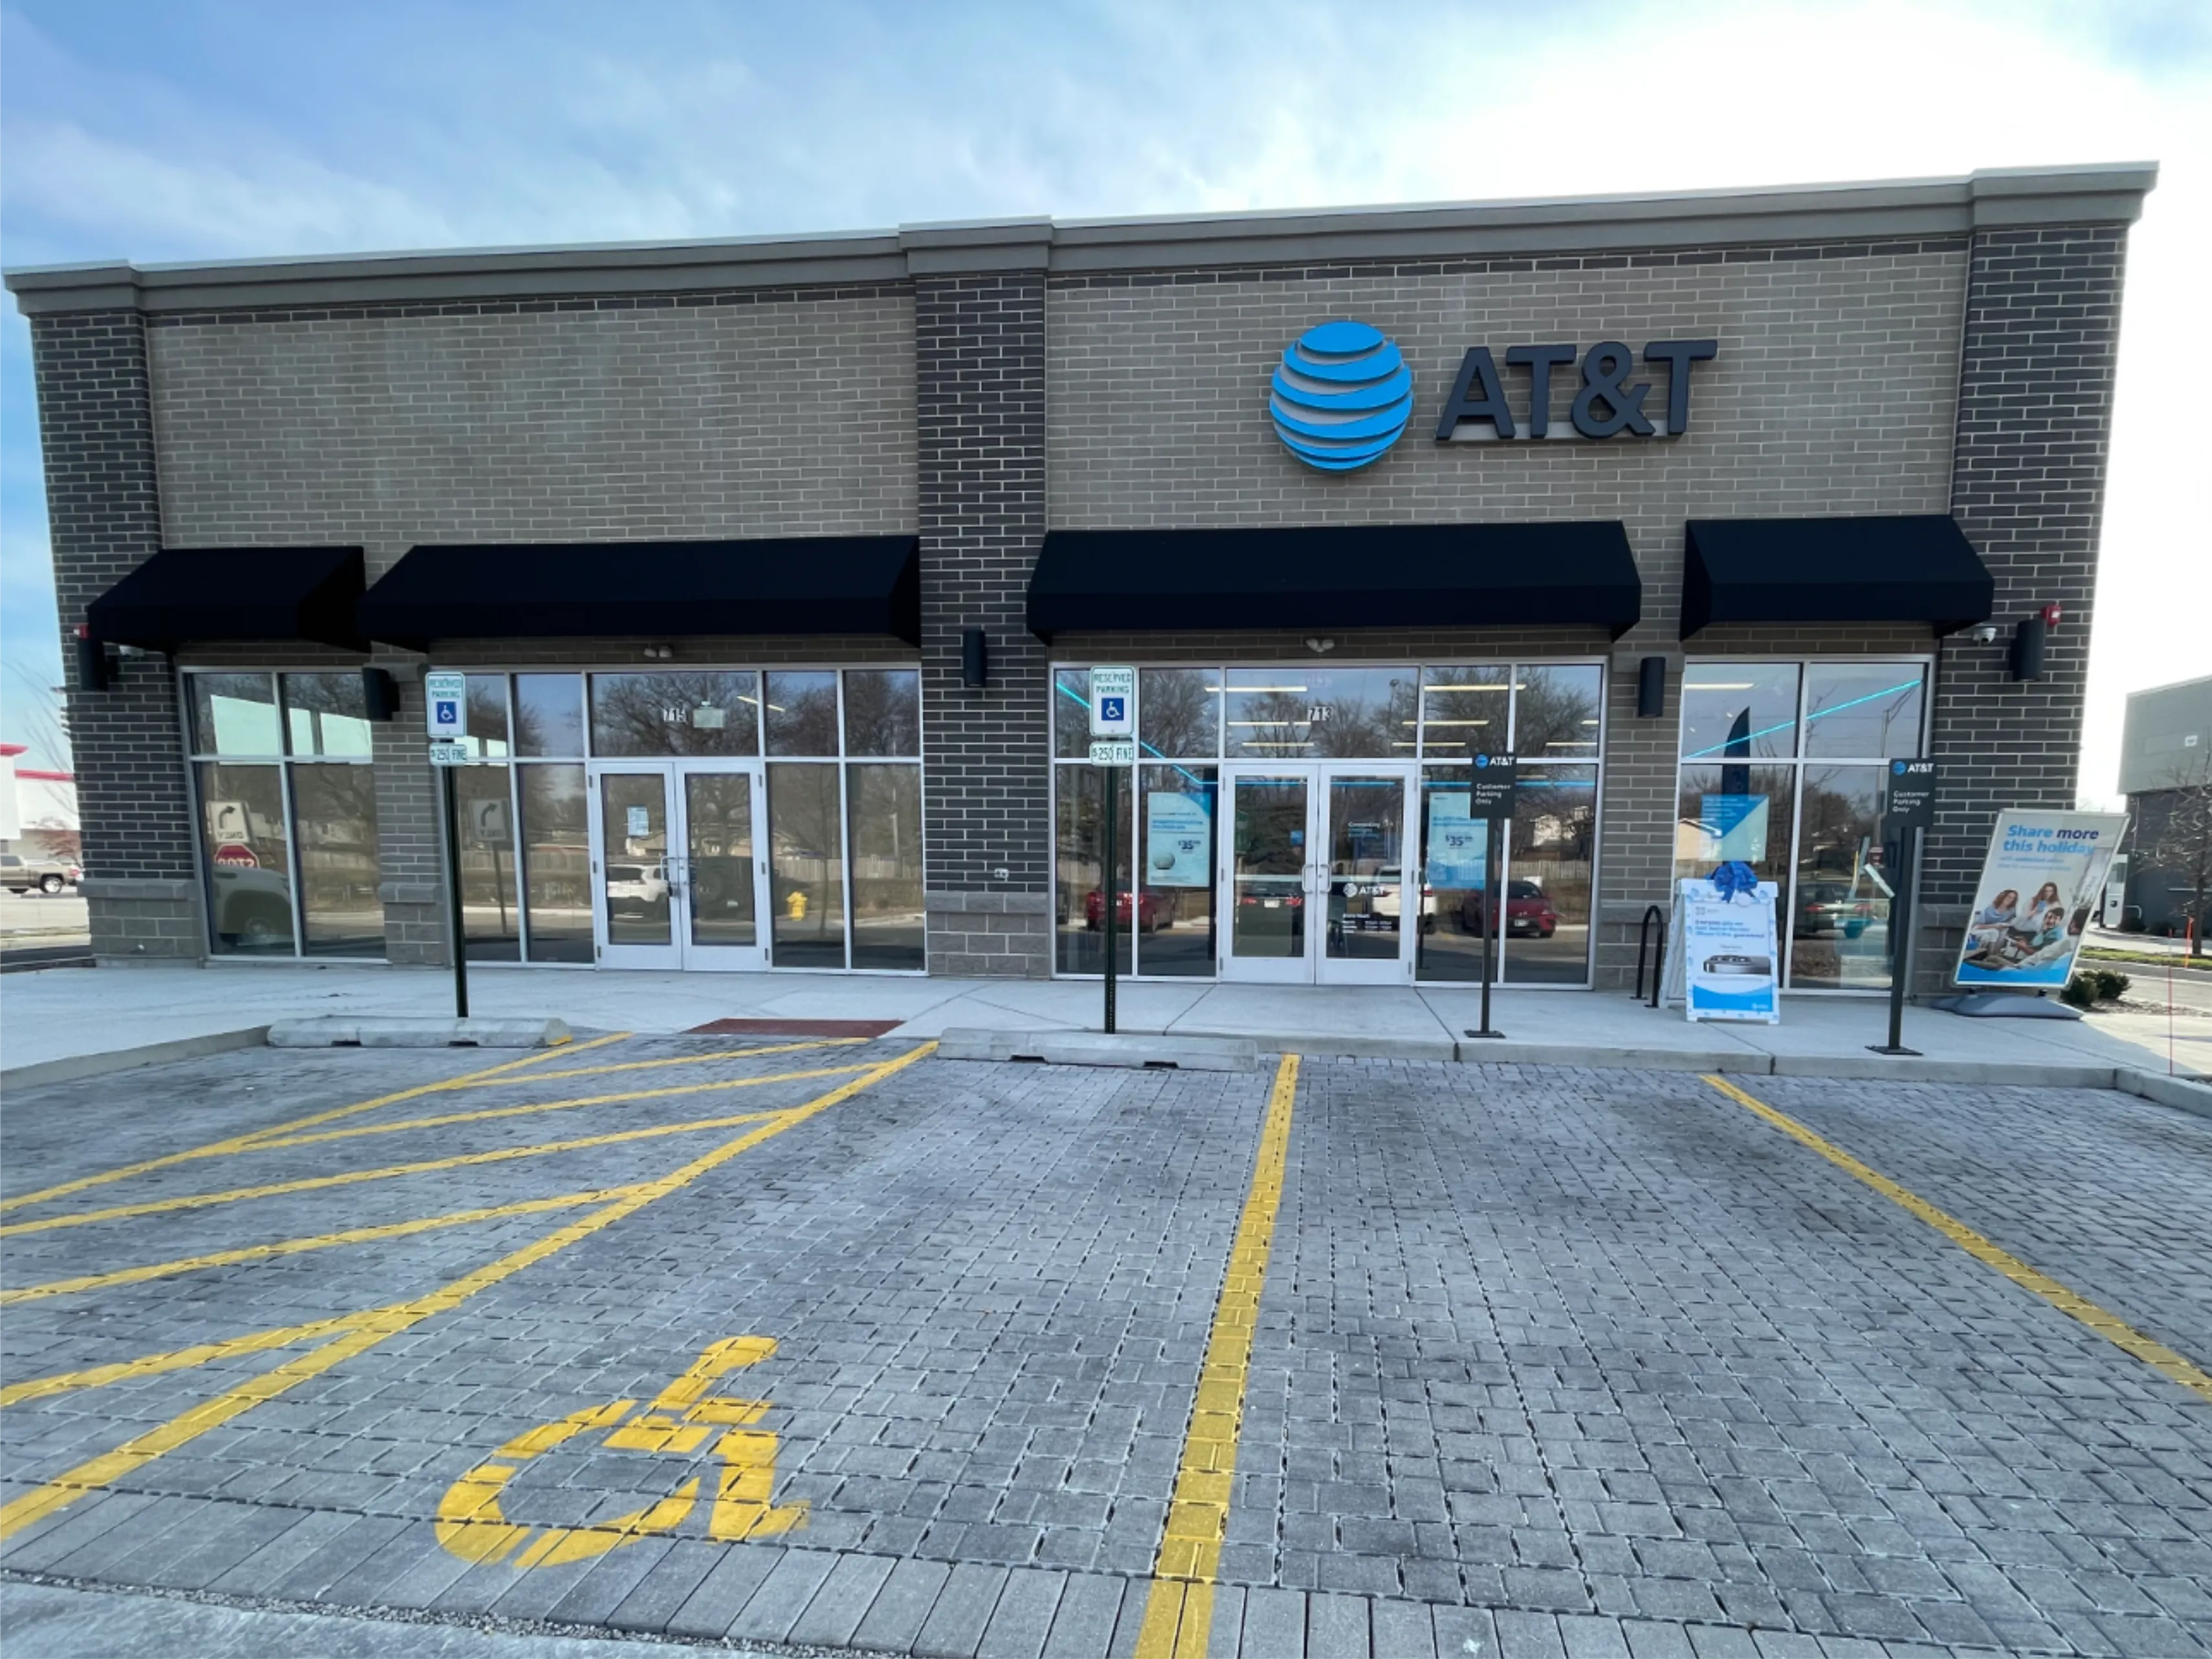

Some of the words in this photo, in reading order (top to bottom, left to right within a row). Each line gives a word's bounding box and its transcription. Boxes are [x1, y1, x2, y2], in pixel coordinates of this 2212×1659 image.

[1435, 339, 1718, 441] AT&T
[1094, 674, 1132, 683] RESERVED
[1310, 707, 1333, 721] 713
[1116, 747, 1133, 760] FINE
[1489, 756, 1515, 766] AT&T
[1907, 763, 1934, 773] AT&T
[2007, 824, 2053, 838] Share
[2057, 829, 2099, 839] more
[2004, 840, 2033, 851] this
[2037, 840, 2096, 856] holiday
[1359, 886, 1385, 895] AT&T
